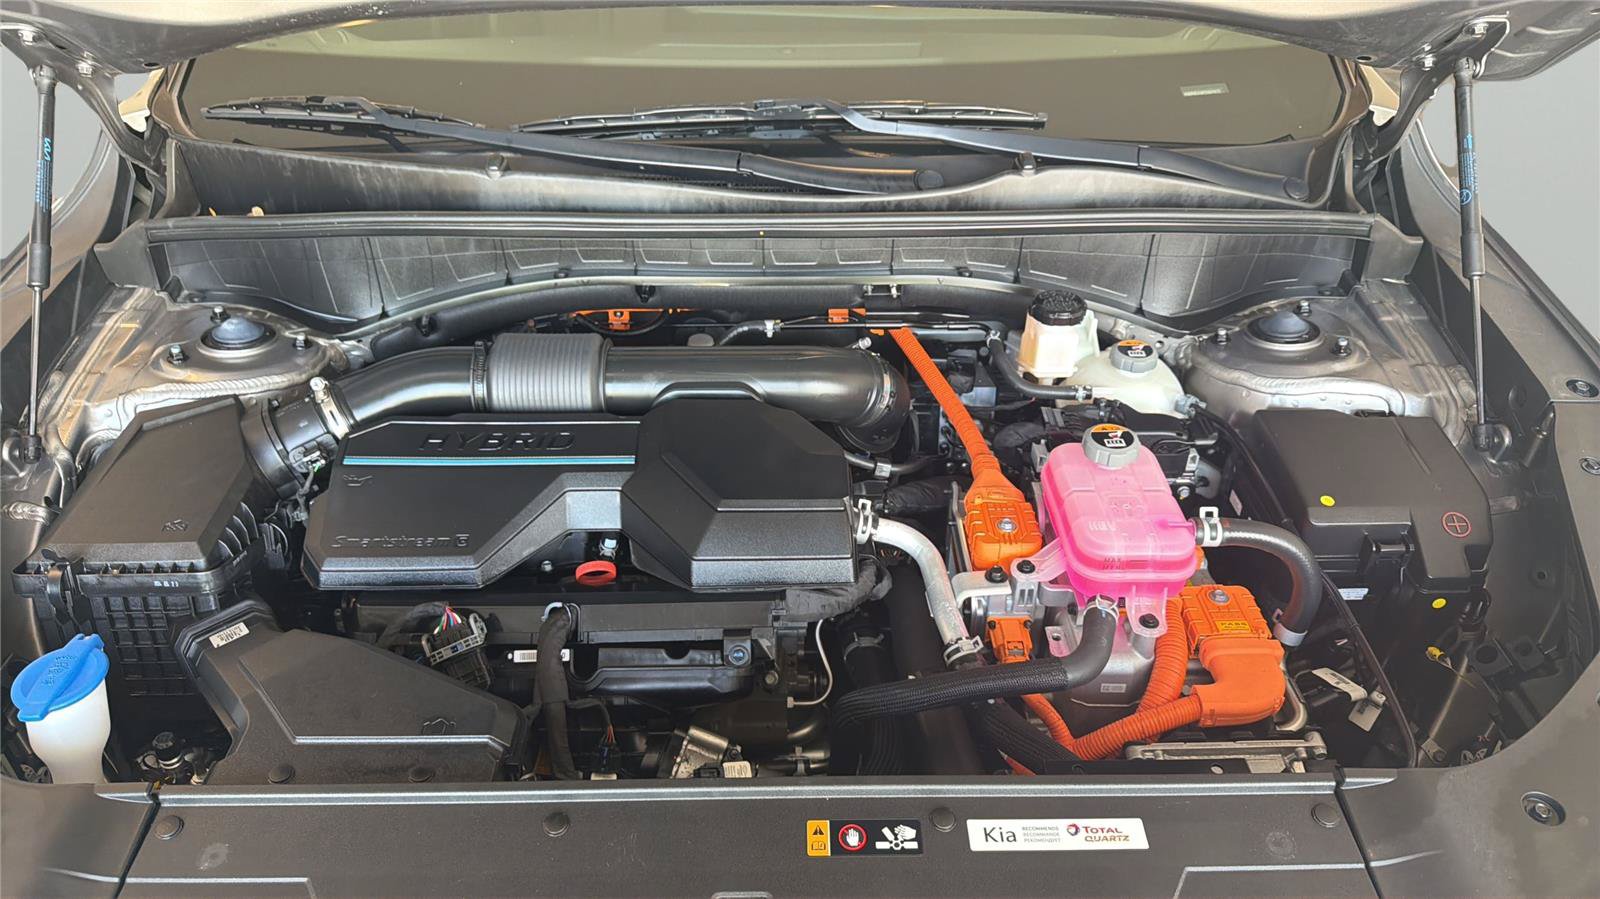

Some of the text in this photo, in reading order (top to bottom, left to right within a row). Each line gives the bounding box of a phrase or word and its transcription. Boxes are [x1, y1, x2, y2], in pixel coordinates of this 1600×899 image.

[418, 431, 576, 451] HYBRID
[331, 534, 470, 547] Smartstream G
[983, 827, 1017, 843] Kia
